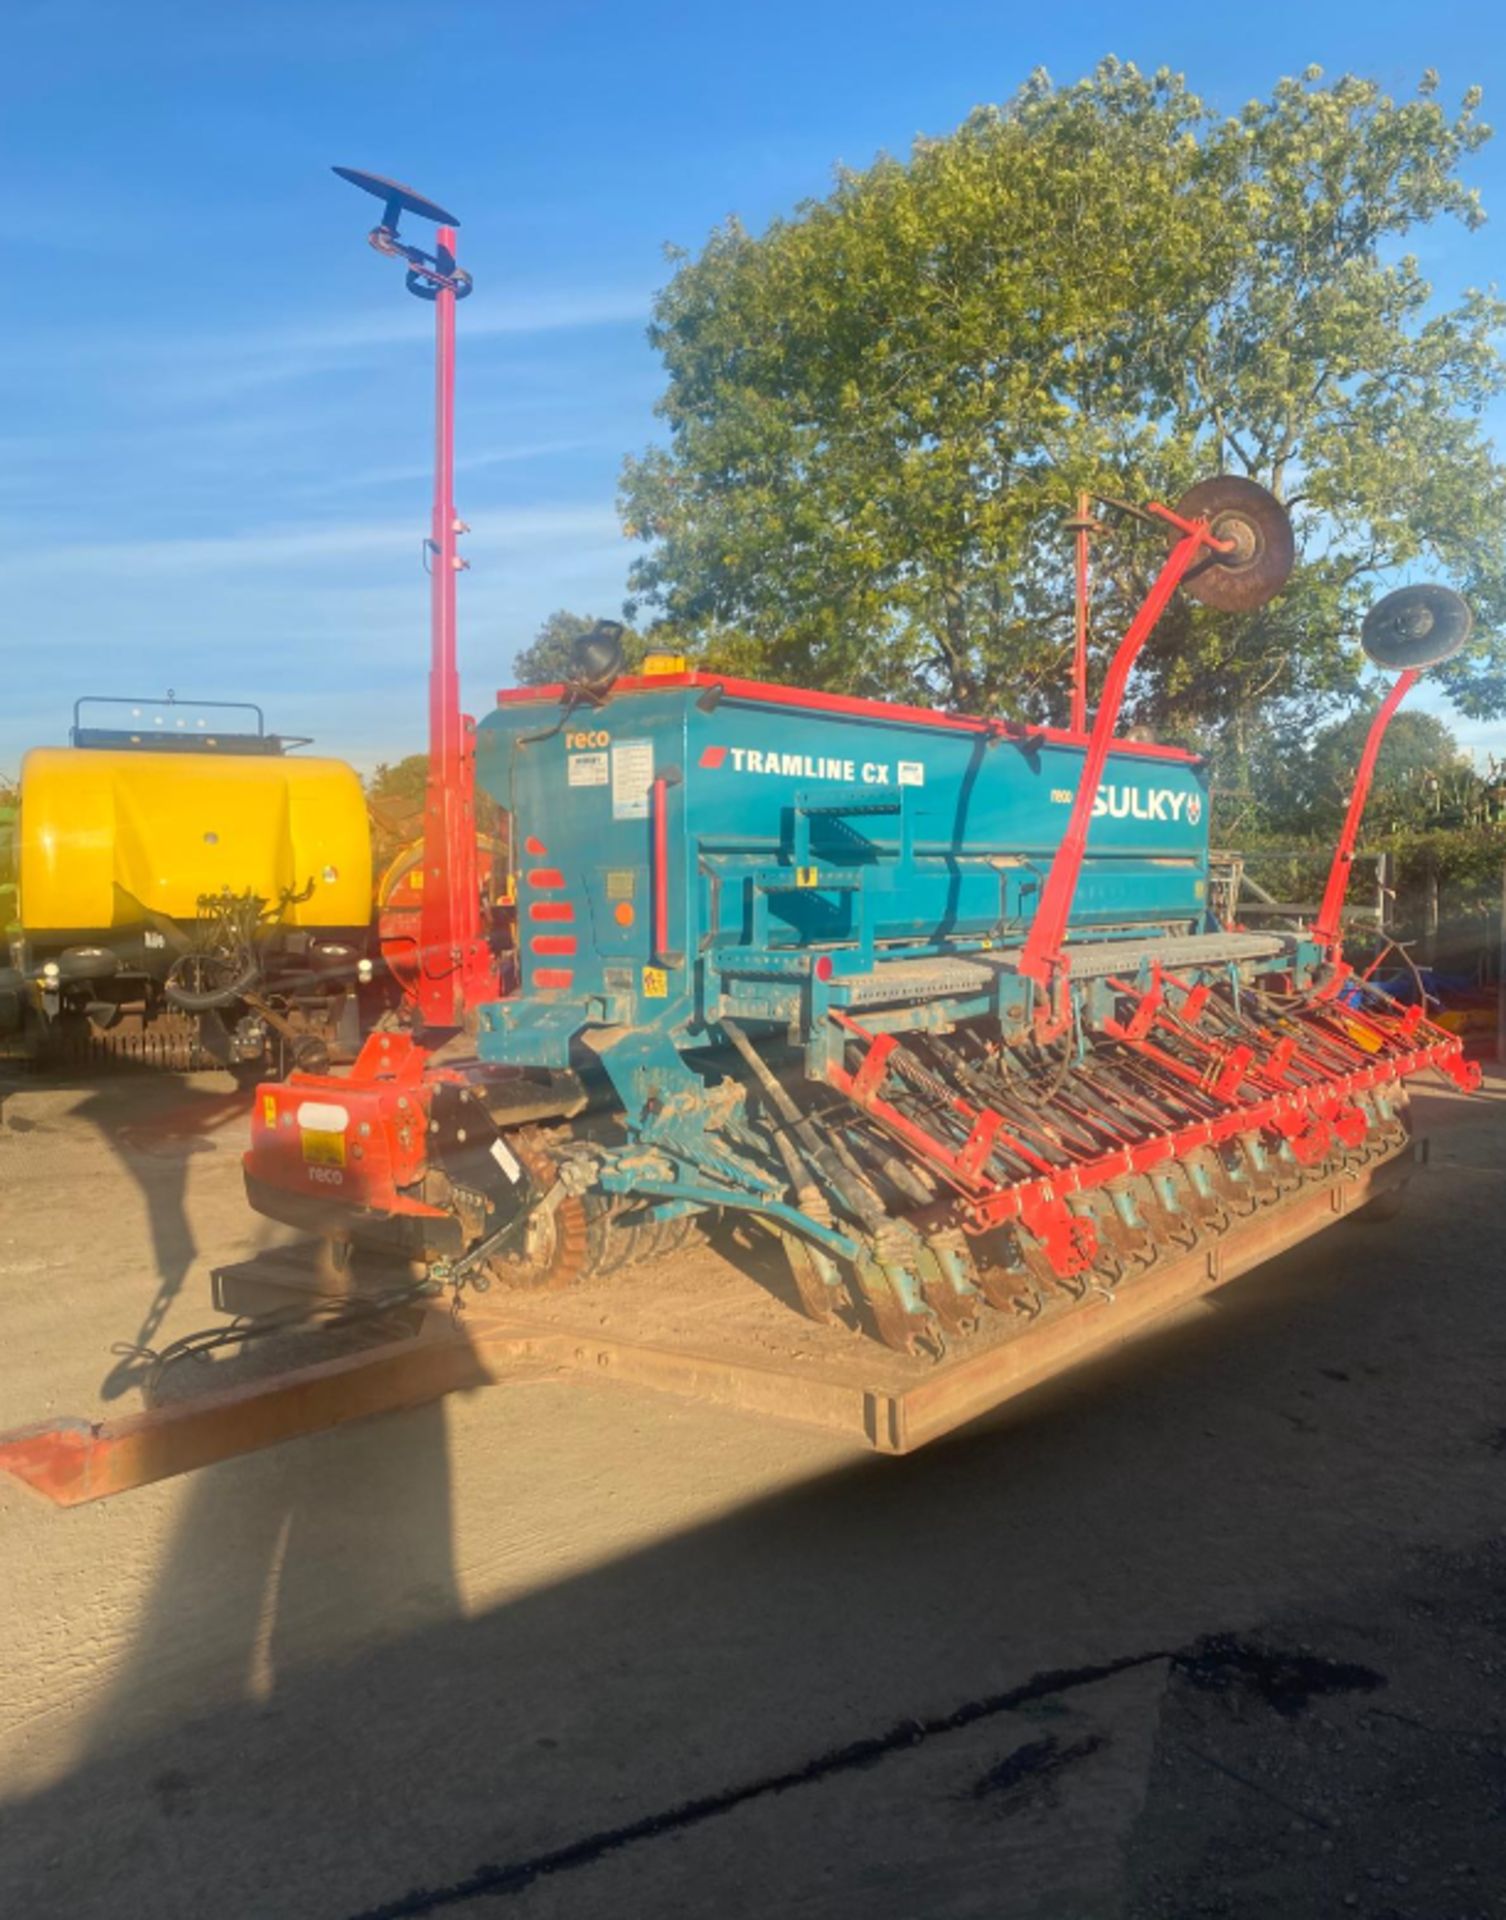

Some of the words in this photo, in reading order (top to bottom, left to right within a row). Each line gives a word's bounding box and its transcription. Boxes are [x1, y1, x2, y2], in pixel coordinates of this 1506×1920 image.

[565, 731, 610, 750] reco
[731, 748, 855, 782] TRAMLINE
[861, 762, 889, 785] CX
[1090, 784, 1186, 820] SULKY
[309, 1167, 343, 1185] reco
